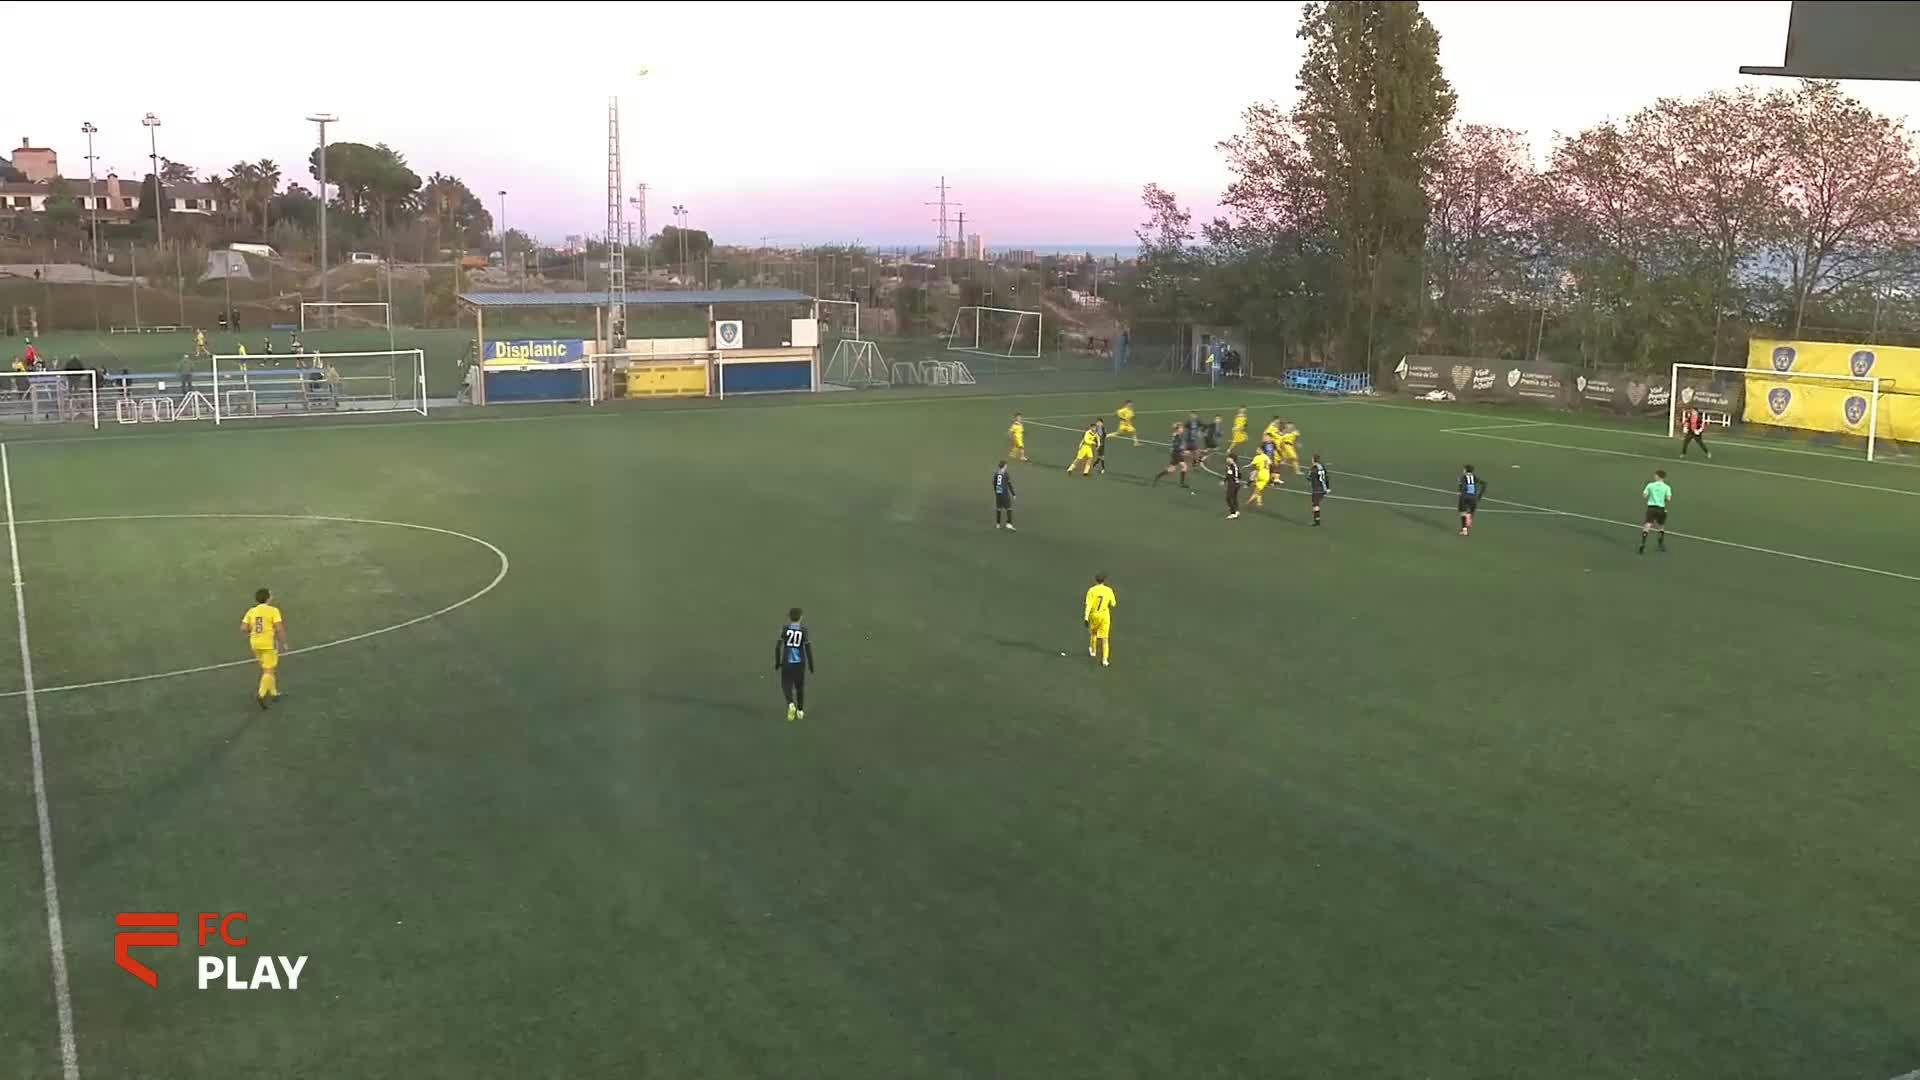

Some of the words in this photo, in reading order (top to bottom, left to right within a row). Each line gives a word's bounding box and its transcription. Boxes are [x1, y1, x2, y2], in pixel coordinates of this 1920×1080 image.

[495, 340, 567, 361] Displanic
[1097, 595, 1104, 612] 7
[786, 629, 803, 647] 20
